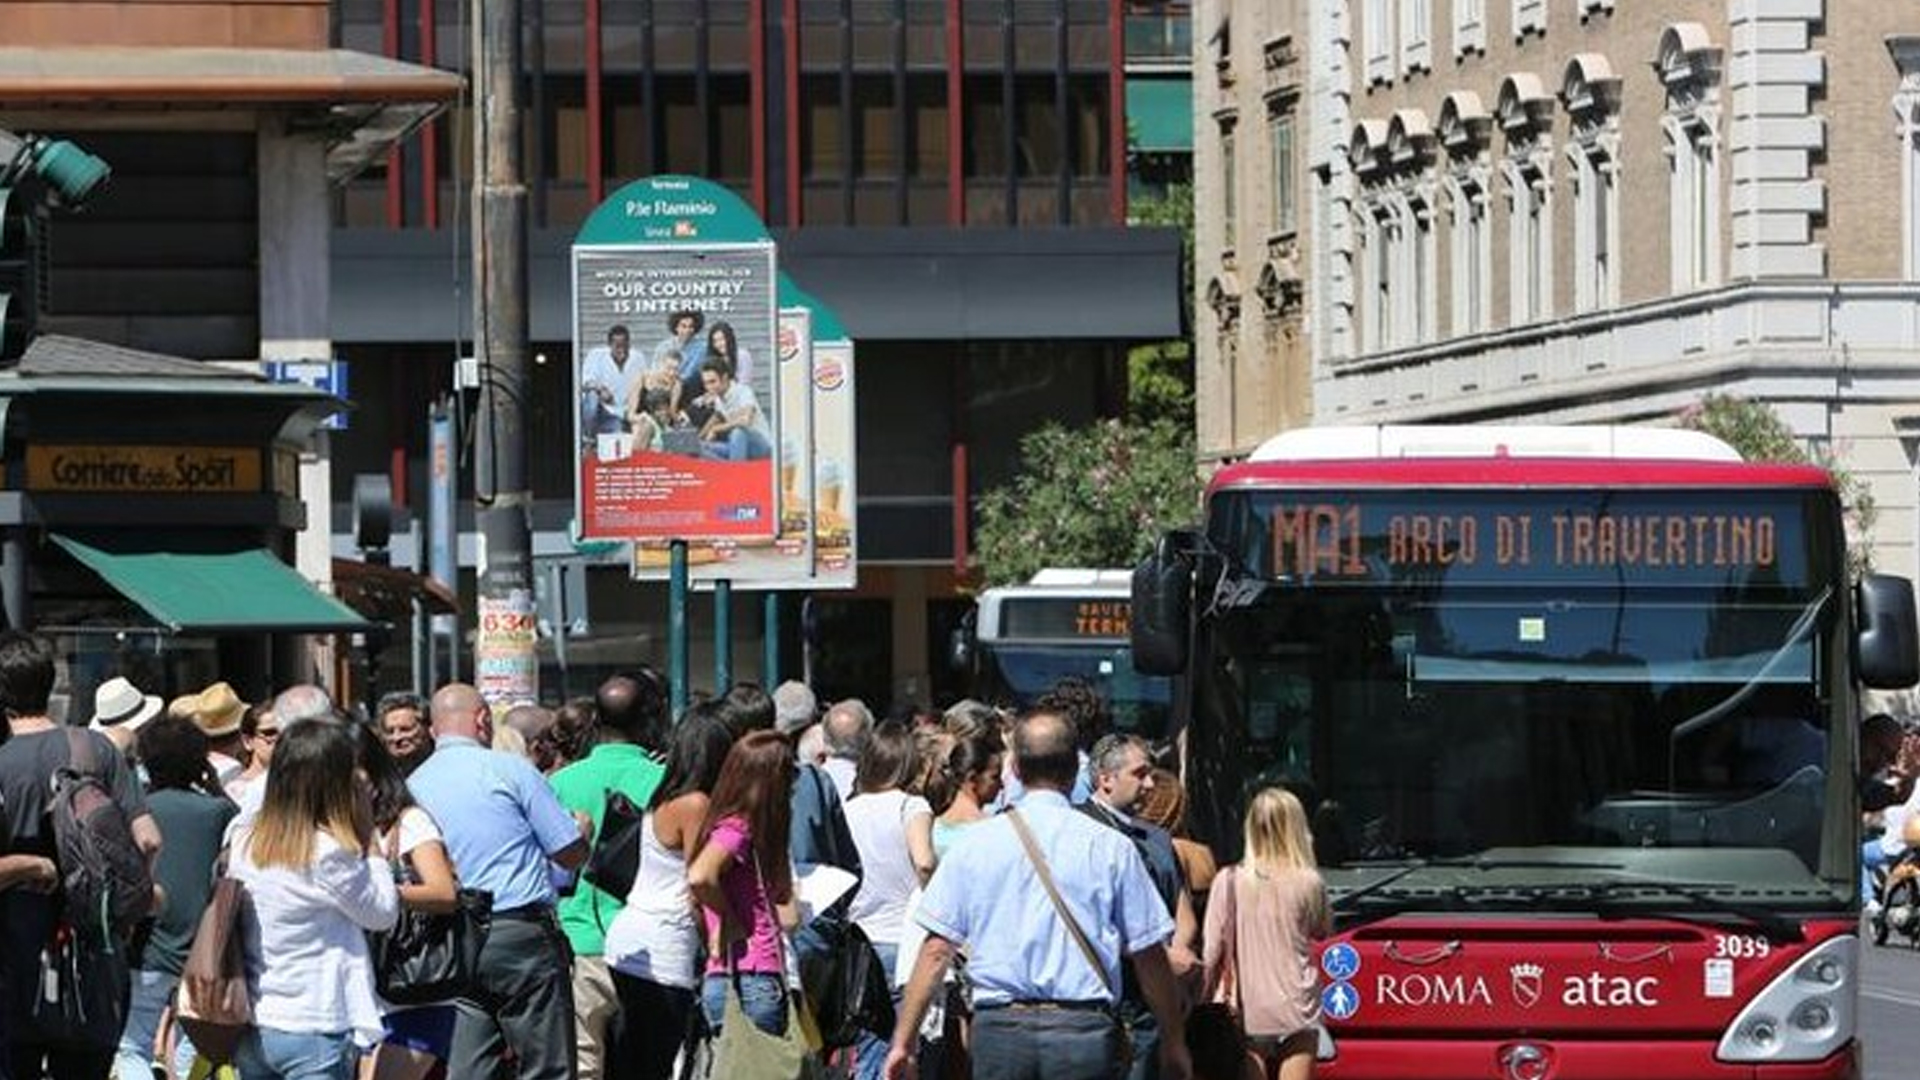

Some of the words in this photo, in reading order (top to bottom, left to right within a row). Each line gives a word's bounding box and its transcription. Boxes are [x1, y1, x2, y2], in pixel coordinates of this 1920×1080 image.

[654, 199, 717, 215] Flaminio
[603, 282, 647, 297] OUR
[650, 279, 744, 297] COUNTRY
[614, 300, 631, 313] IS
[52, 455, 140, 485] Corriere
[174, 453, 236, 491] Sport
[1272, 504, 1366, 575] MA1
[1389, 515, 1477, 565] ARCO
[1496, 514, 1532, 565] DI
[1552, 514, 1775, 567] TRAVERTINO
[1713, 934, 1770, 958] 3039
[1376, 973, 1492, 1005] ROMA
[1563, 970, 1659, 1006] atac
